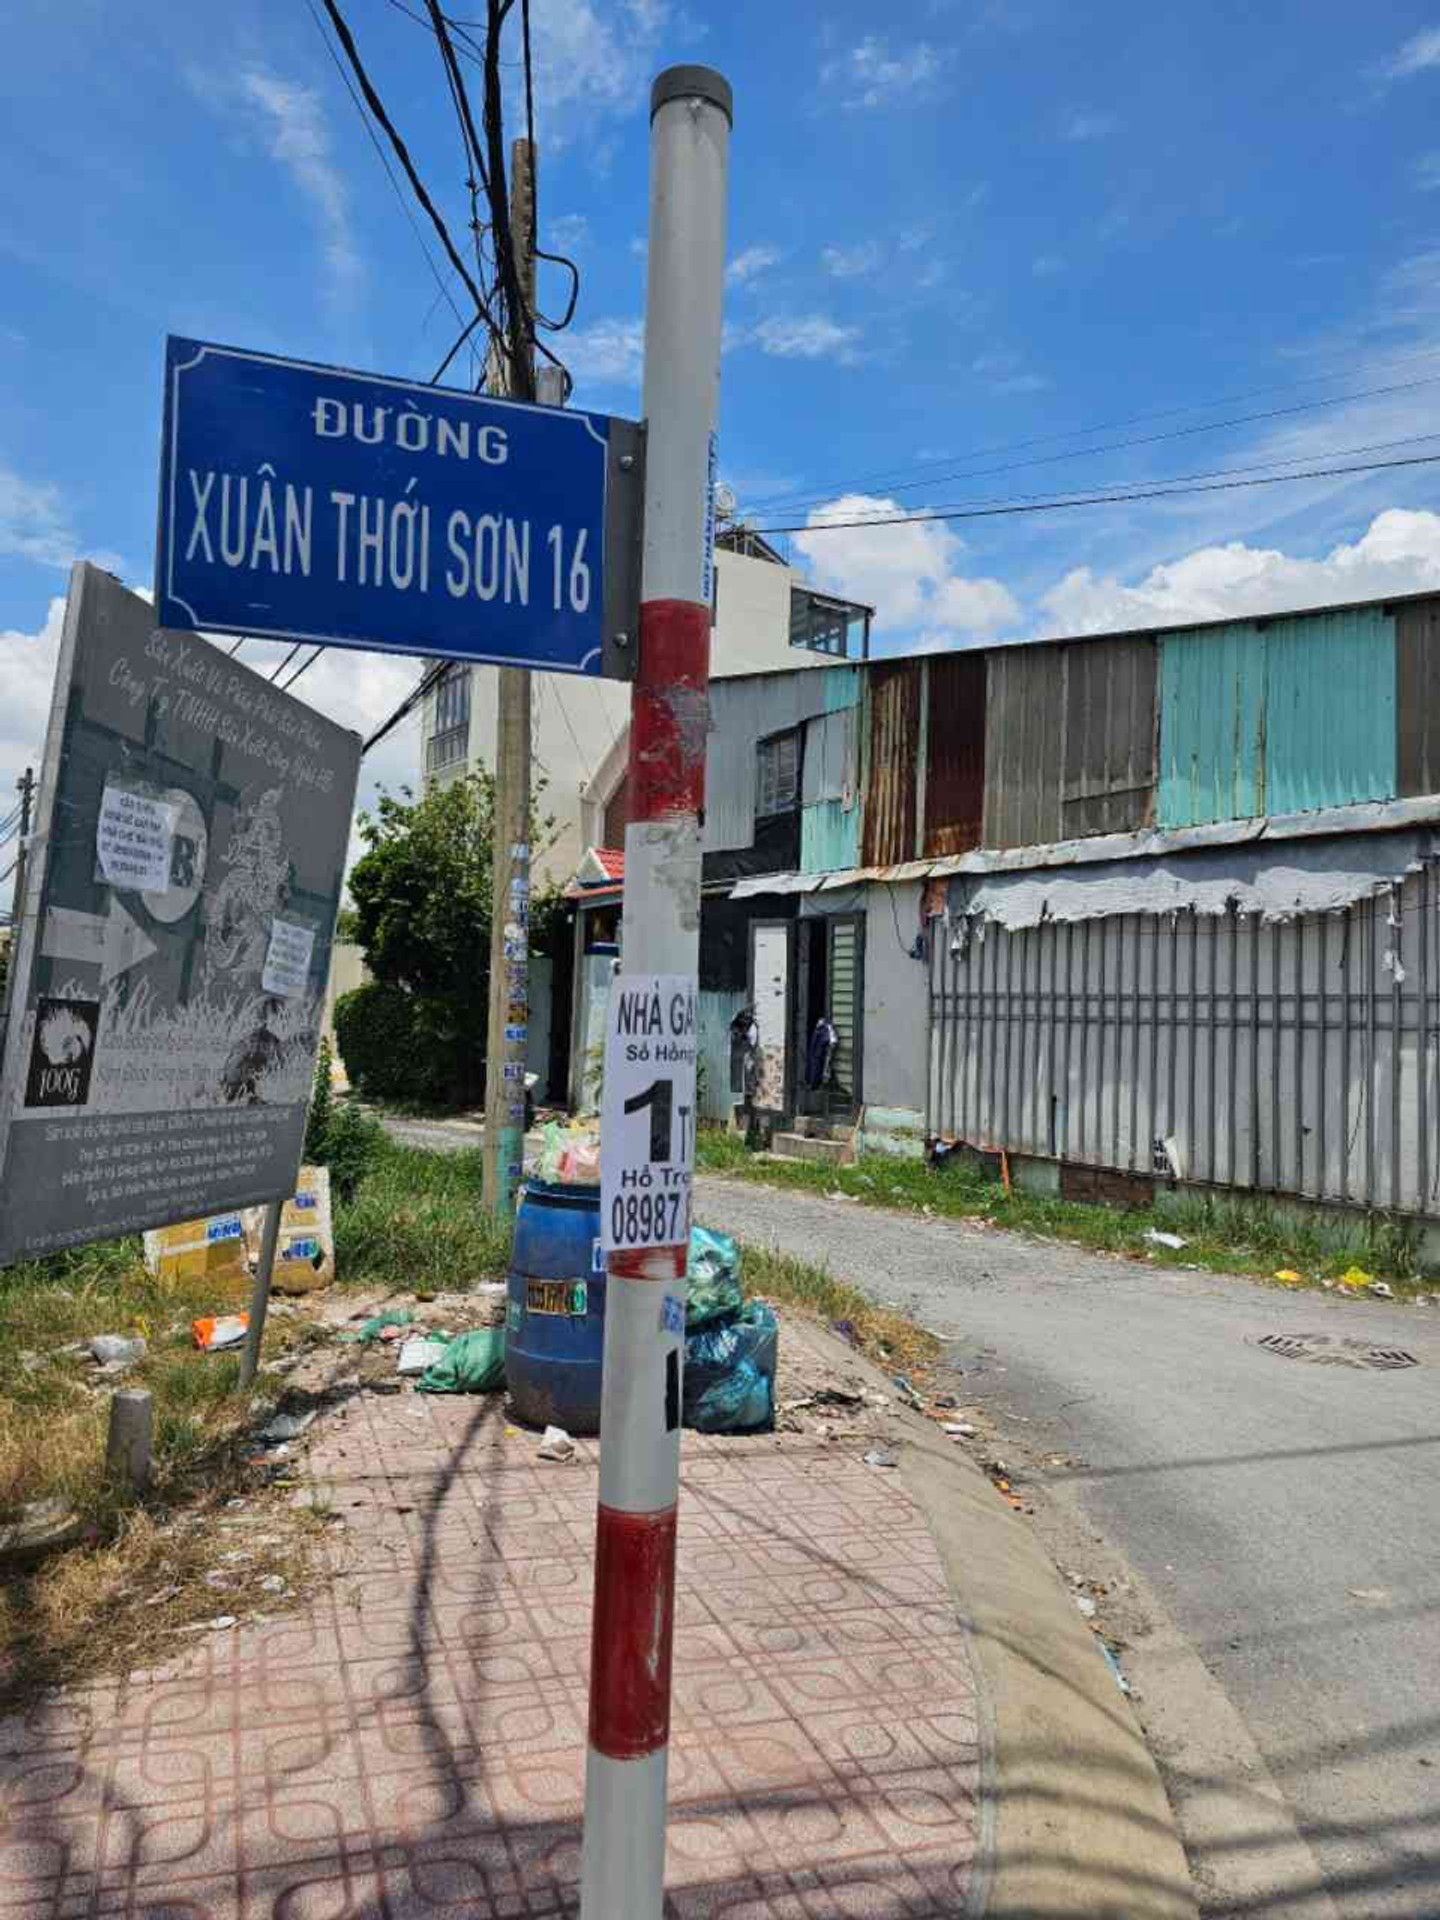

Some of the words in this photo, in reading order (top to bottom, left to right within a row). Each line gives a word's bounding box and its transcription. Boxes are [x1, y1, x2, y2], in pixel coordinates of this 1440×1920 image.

[310, 397, 509, 465] ĐƯỜNG
[185, 463, 313, 577] XUÂN
[330, 477, 431, 593] THỚI
[445, 508, 531, 606] SƠN
[547, 523, 592, 613] 16
[611, 1191, 691, 1245] 08987
